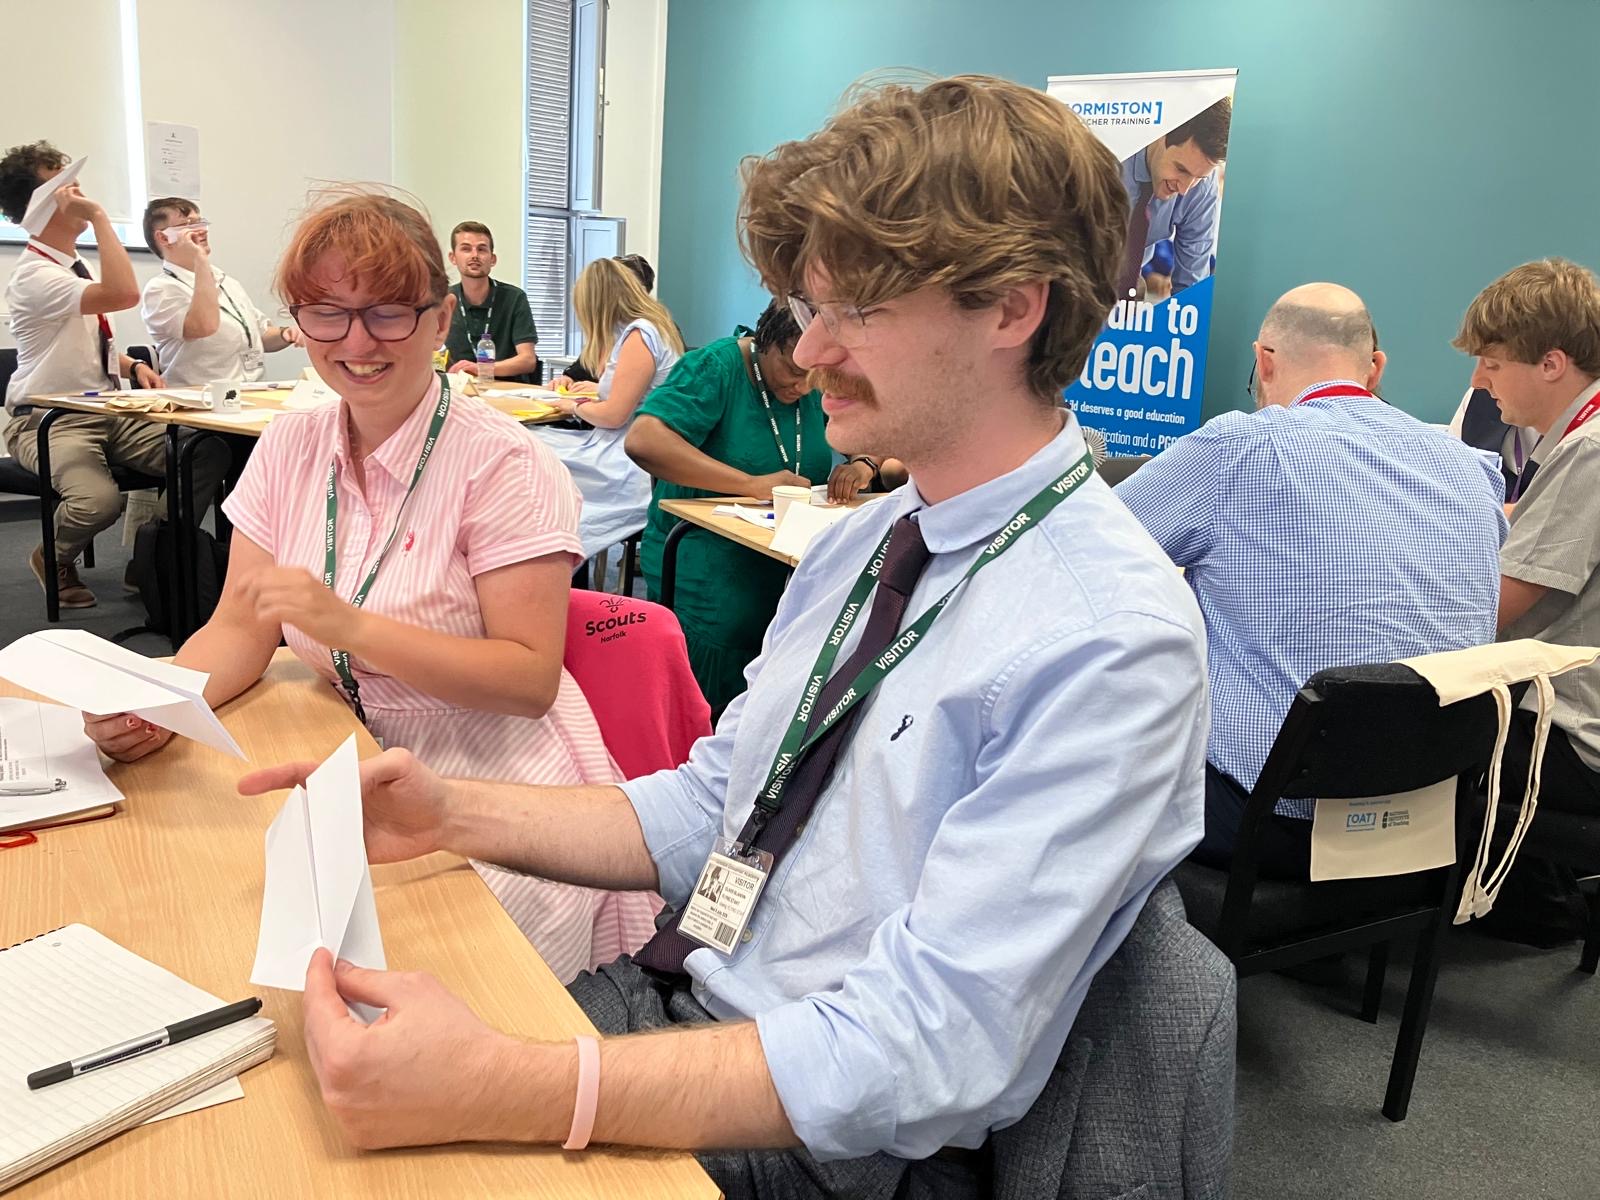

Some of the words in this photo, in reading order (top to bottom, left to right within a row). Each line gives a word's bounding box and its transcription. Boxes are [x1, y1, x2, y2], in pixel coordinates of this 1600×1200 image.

[1086, 118, 1109, 126] CHER
[1111, 117, 1151, 126] TRAINING
[1108, 287, 1154, 333] ain
[1167, 298, 1199, 336] to
[1080, 401, 1115, 416] deserves
[1116, 408, 1123, 417] a
[1123, 408, 1144, 421] good
[1145, 409, 1185, 425] education
[417, 437, 435, 470] VISITOR
[1098, 427, 1131, 446] fication
[1132, 433, 1149, 448] and
[1150, 438, 1157, 449] a
[1158, 434, 1181, 450] PGC
[1051, 462, 1089, 495] VISITOR
[985, 512, 1031, 555] VISITOR
[586, 611, 647, 636] Scouts
[601, 630, 627, 643] Norfolk
[829, 602, 860, 646] VISITOR
[875, 630, 919, 671] VISITOR
[798, 675, 823, 722] VISITOR
[823, 687, 857, 726] VISITOR
[734, 876, 755, 891] VISITOR
